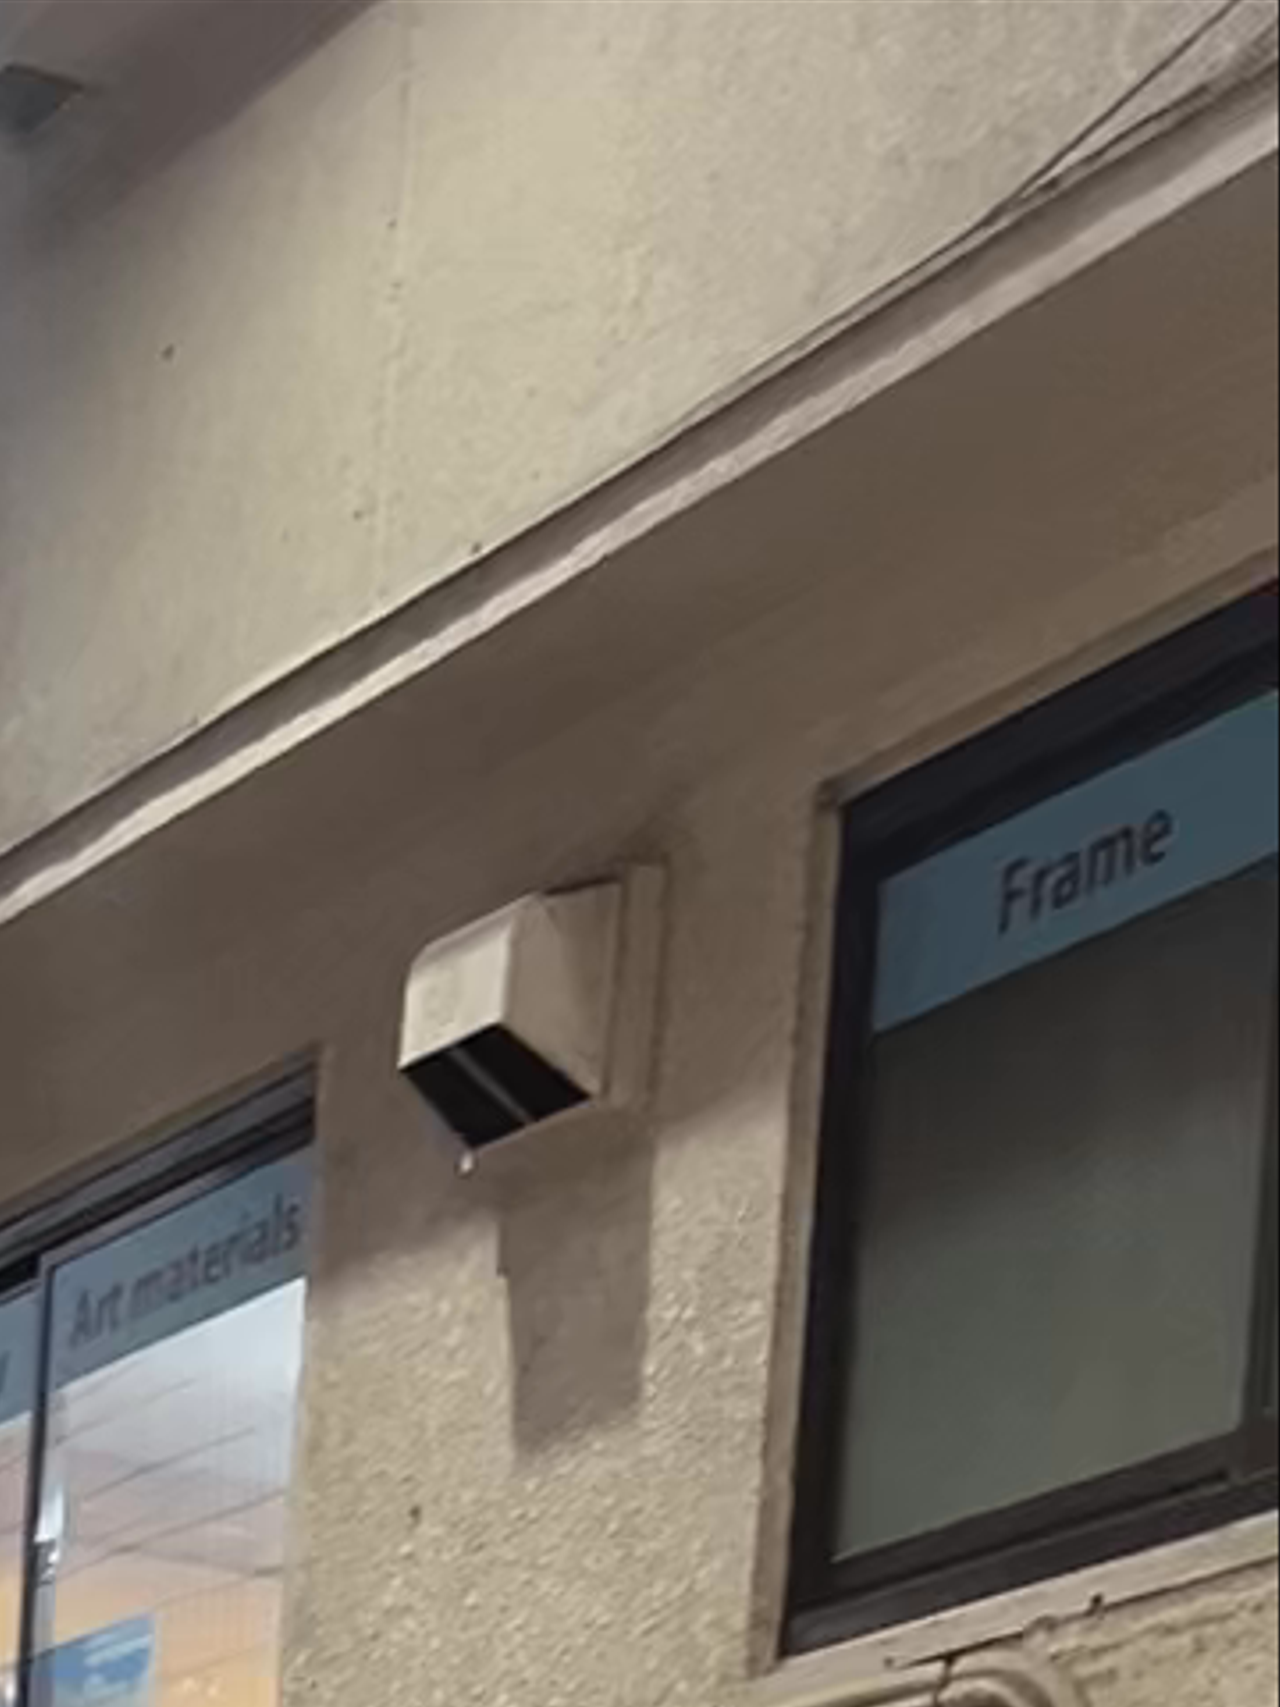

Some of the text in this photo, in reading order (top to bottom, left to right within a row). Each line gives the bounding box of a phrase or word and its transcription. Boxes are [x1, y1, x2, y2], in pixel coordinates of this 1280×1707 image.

[996, 808, 1176, 936] Frame
[68, 1192, 302, 1351] Art materials
